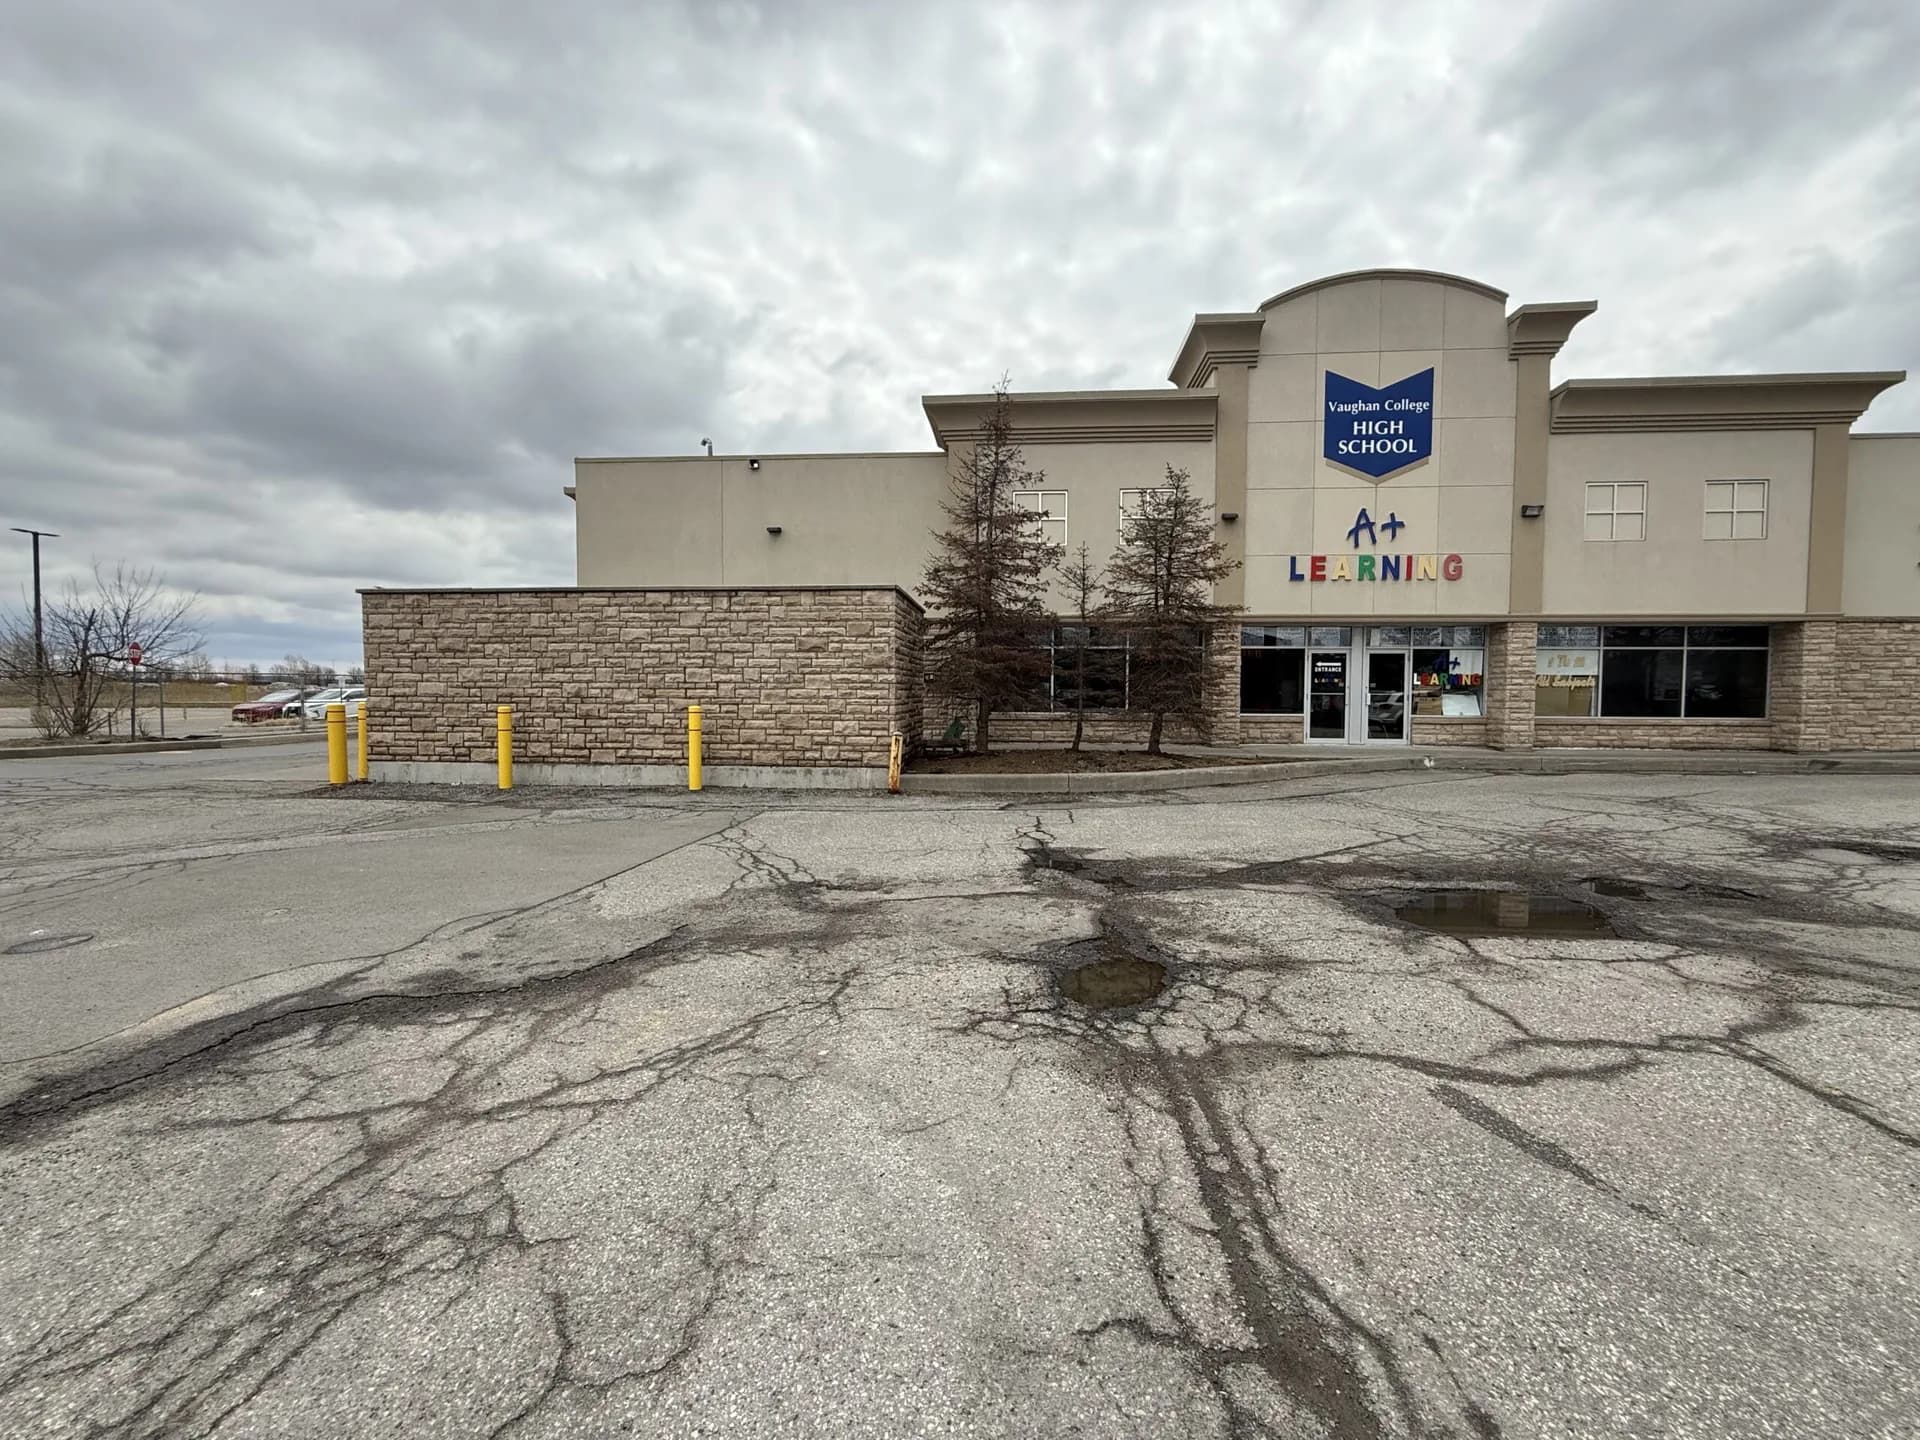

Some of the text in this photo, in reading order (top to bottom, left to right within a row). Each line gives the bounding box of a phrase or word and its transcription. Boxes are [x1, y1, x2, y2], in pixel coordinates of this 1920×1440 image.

[1328, 399, 1430, 414] Vaughan College
[1353, 420, 1404, 435] HIGH
[1338, 439, 1417, 455] SCHOOL
[1346, 508, 1405, 549] A+
[1289, 554, 1463, 582] LEARNING
[1414, 671, 1481, 687] LEARNING
